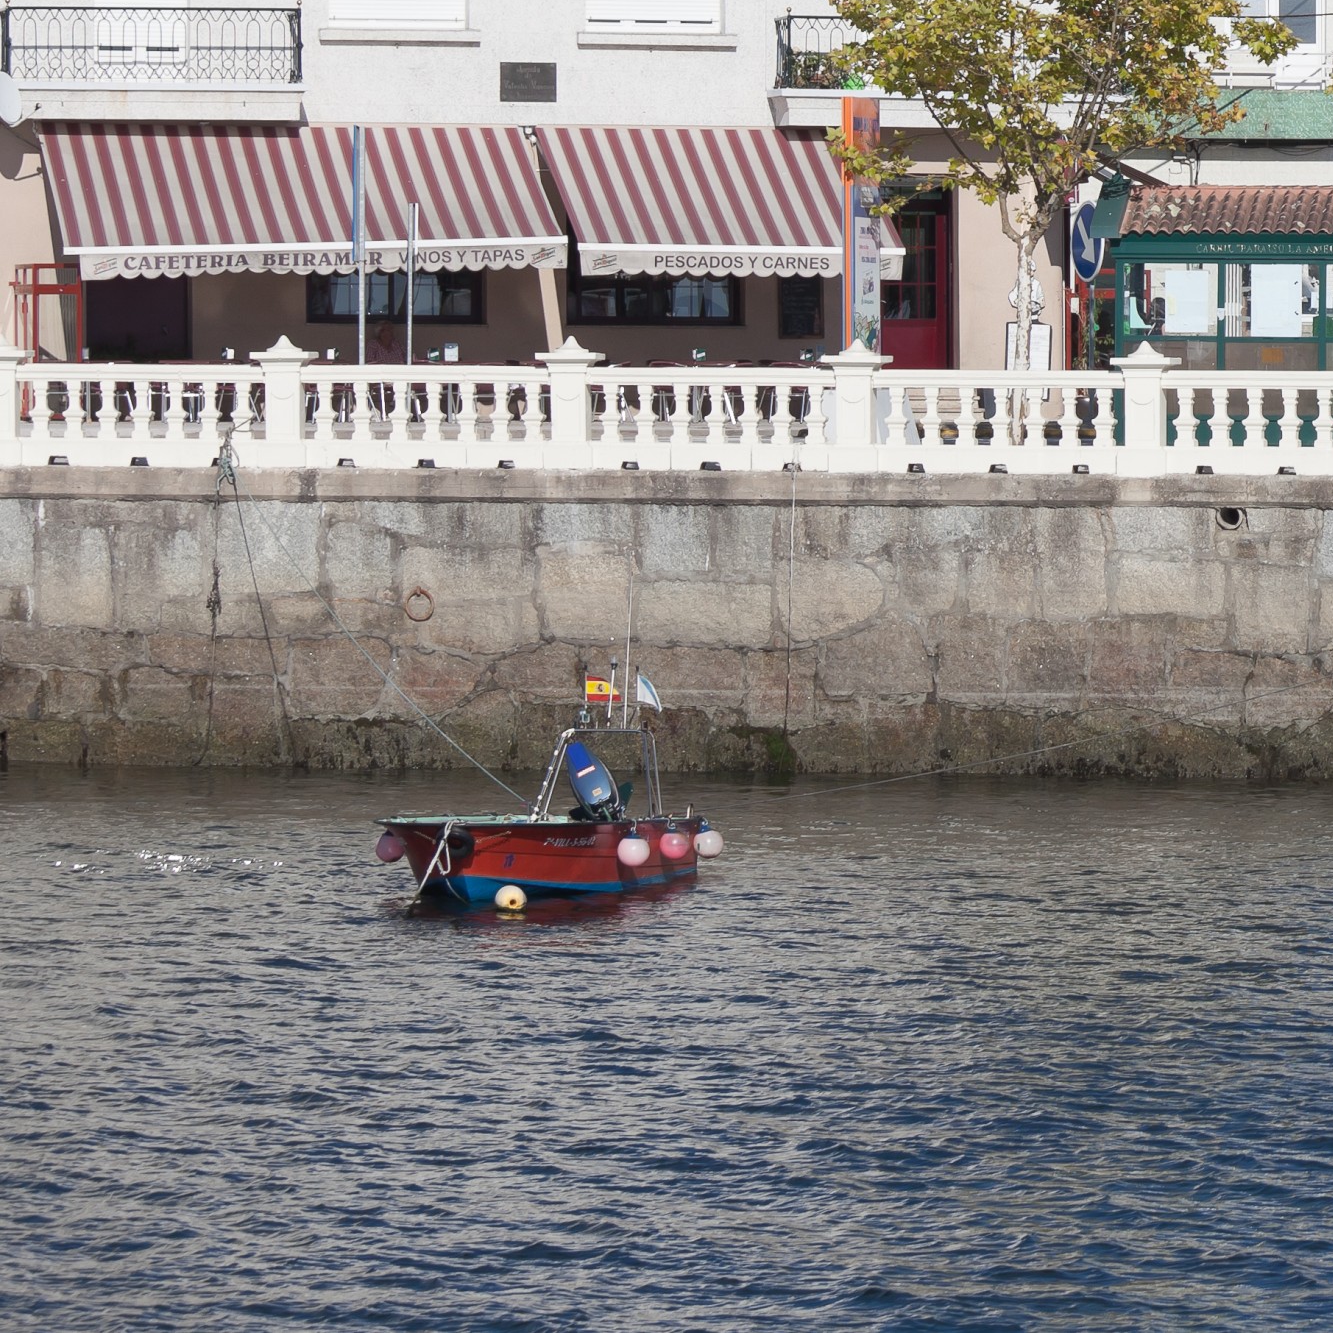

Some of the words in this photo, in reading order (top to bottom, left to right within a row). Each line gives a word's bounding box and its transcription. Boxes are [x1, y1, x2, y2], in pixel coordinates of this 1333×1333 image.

[123, 254, 249, 271] CAFETERIA
[262, 251, 383, 267] BEIRAMR
[457, 250, 467, 263] Y
[471, 248, 525, 262] TAPAS
[654, 255, 744, 269] PESCADOS
[748, 256, 758, 269] Y
[762, 256, 830, 270] CARNES
